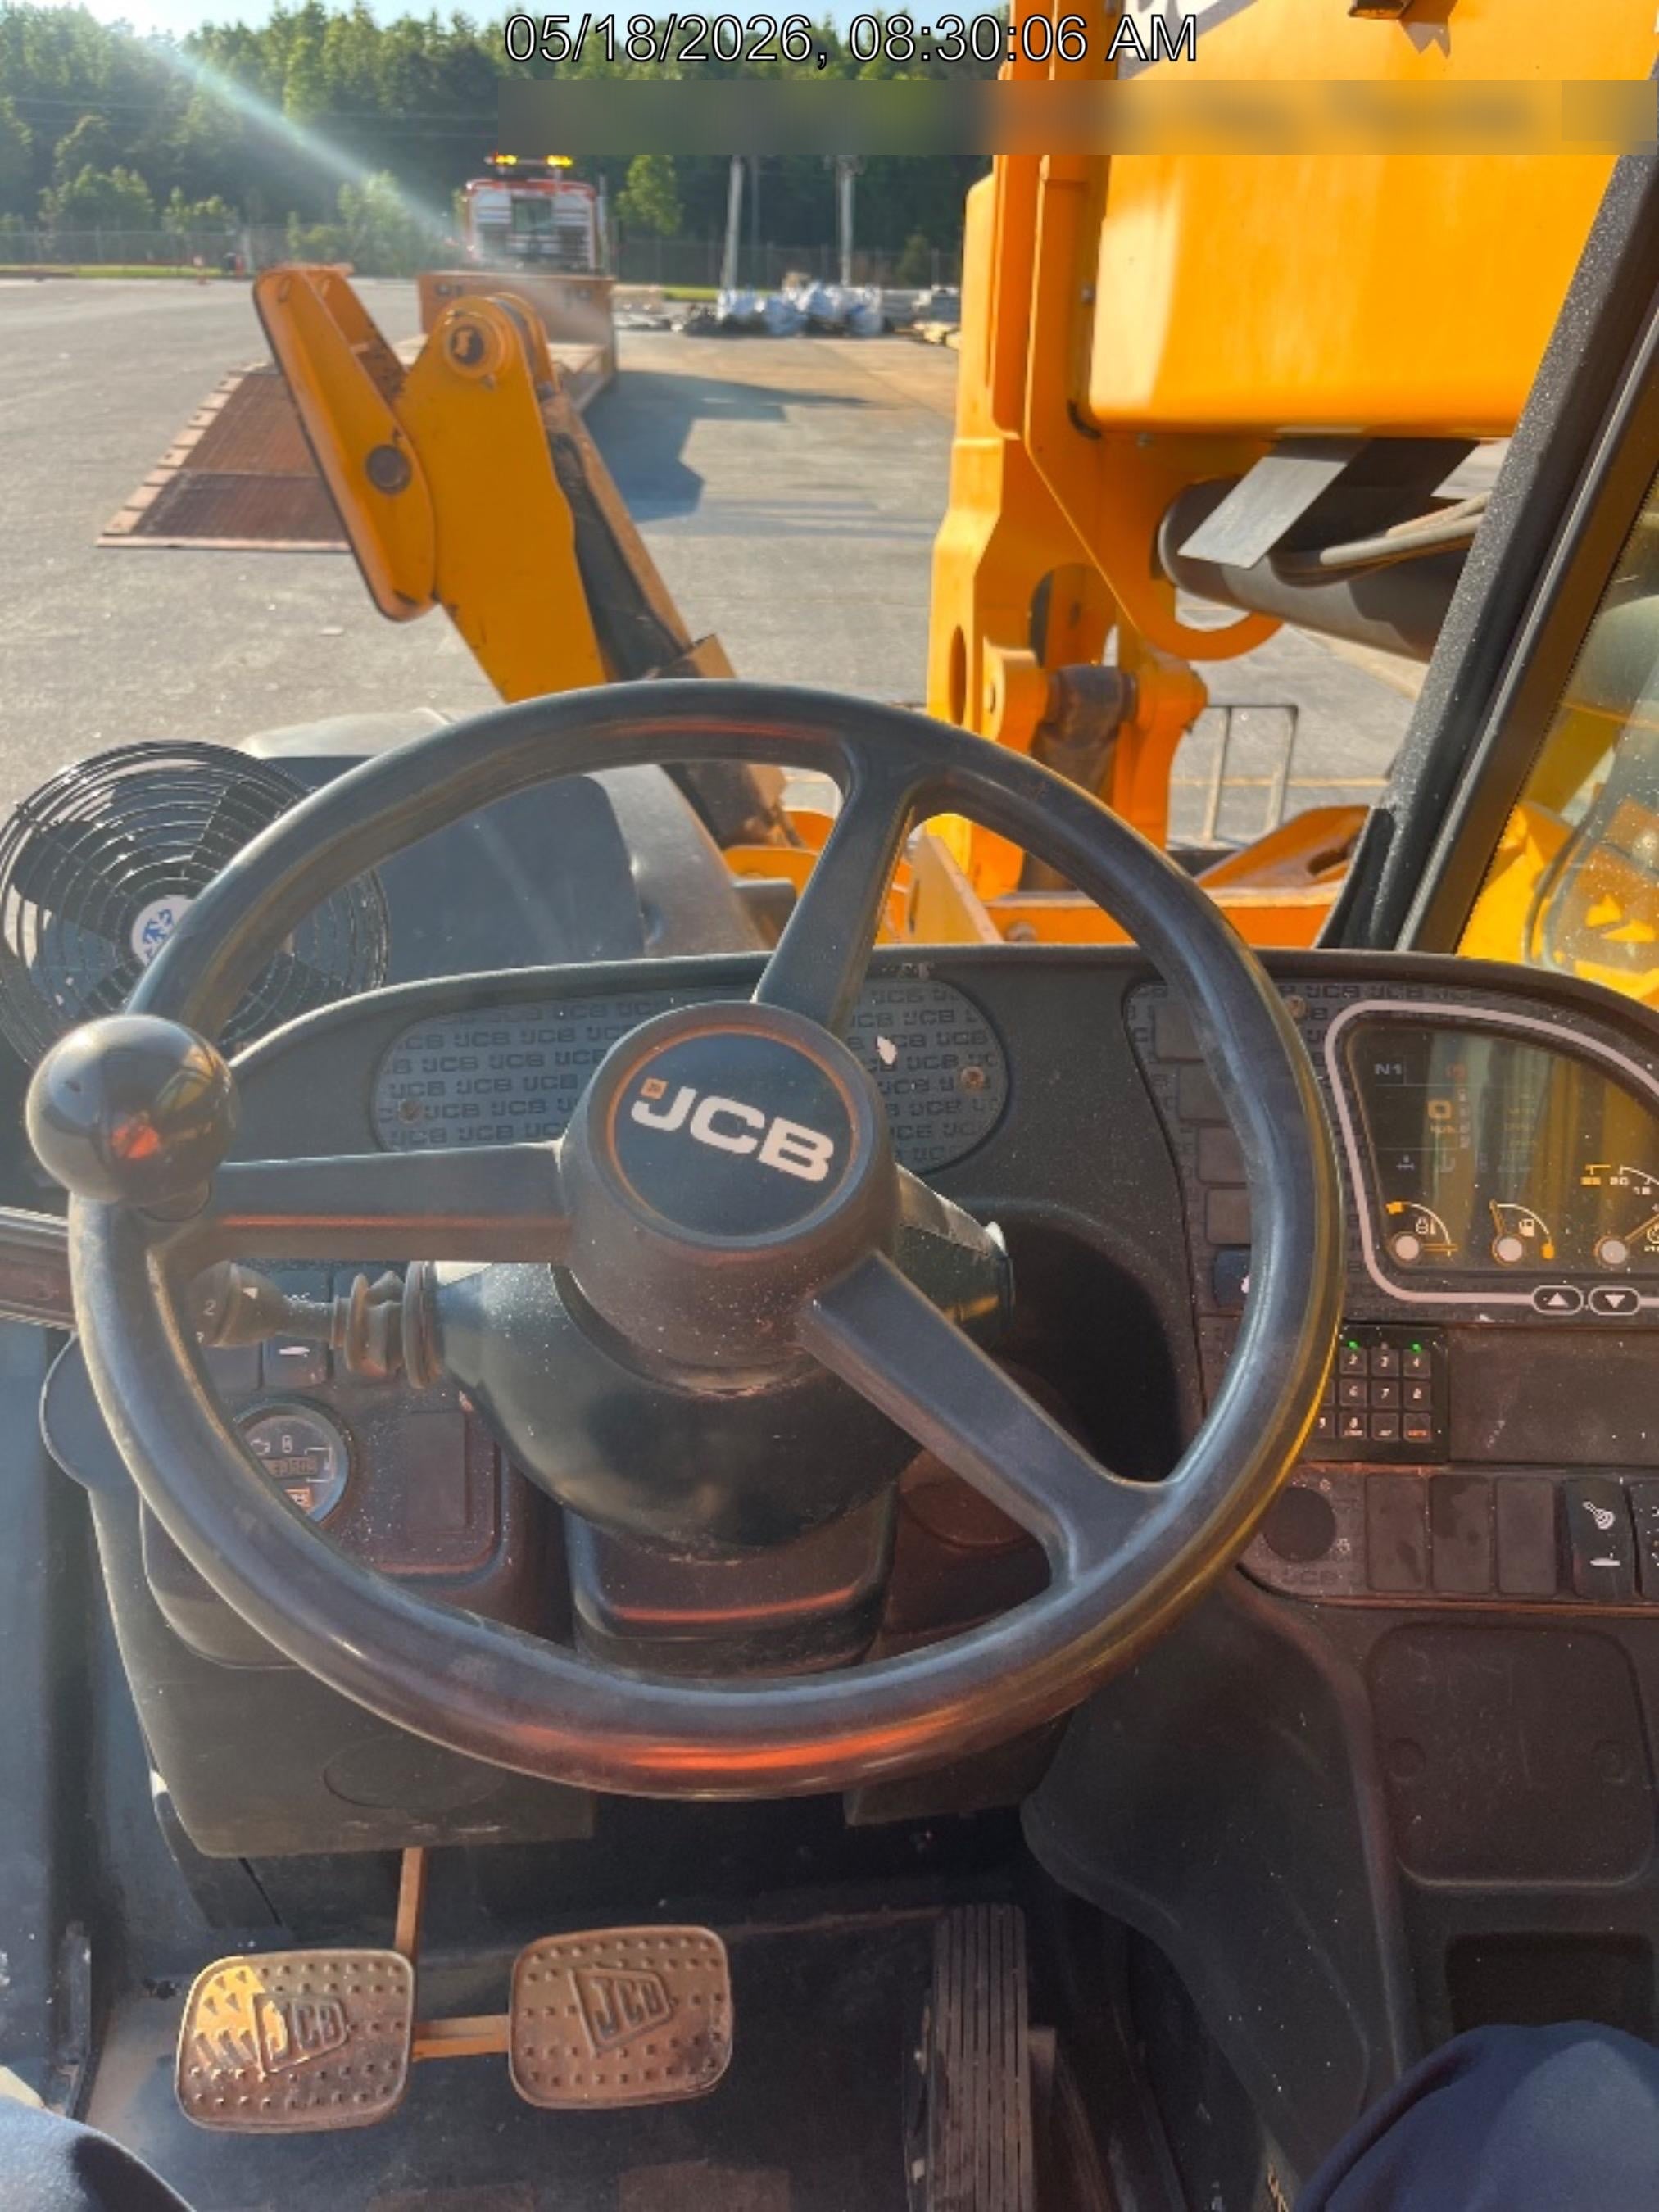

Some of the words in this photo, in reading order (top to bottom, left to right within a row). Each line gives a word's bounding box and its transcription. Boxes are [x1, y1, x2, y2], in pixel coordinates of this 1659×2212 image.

[1307, 985, 1360, 998] JCB
[904, 1009, 954, 1026] JCB
[454, 1032, 510, 1048] JCB
[520, 1027, 575, 1045] JCB
[936, 1031, 987, 1045] JCB
[422, 1056, 479, 1072] JCB
[489, 1054, 545, 1070] JCB
[907, 1054, 959, 1069] JCB
[388, 1081, 445, 1099] JCB
[456, 1078, 512, 1095] JCB
[523, 1074, 578, 1091] JCB
[878, 1079, 930, 1095] JCB
[424, 1104, 480, 1120] JCB
[491, 1100, 546, 1117] JCB
[390, 1127, 447, 1145] JCB
[459, 1125, 514, 1142] JCB
[631, 1078, 834, 1181] JCB
[588, 1976, 664, 2040] JCB
[264, 1999, 342, 2063] JCB
